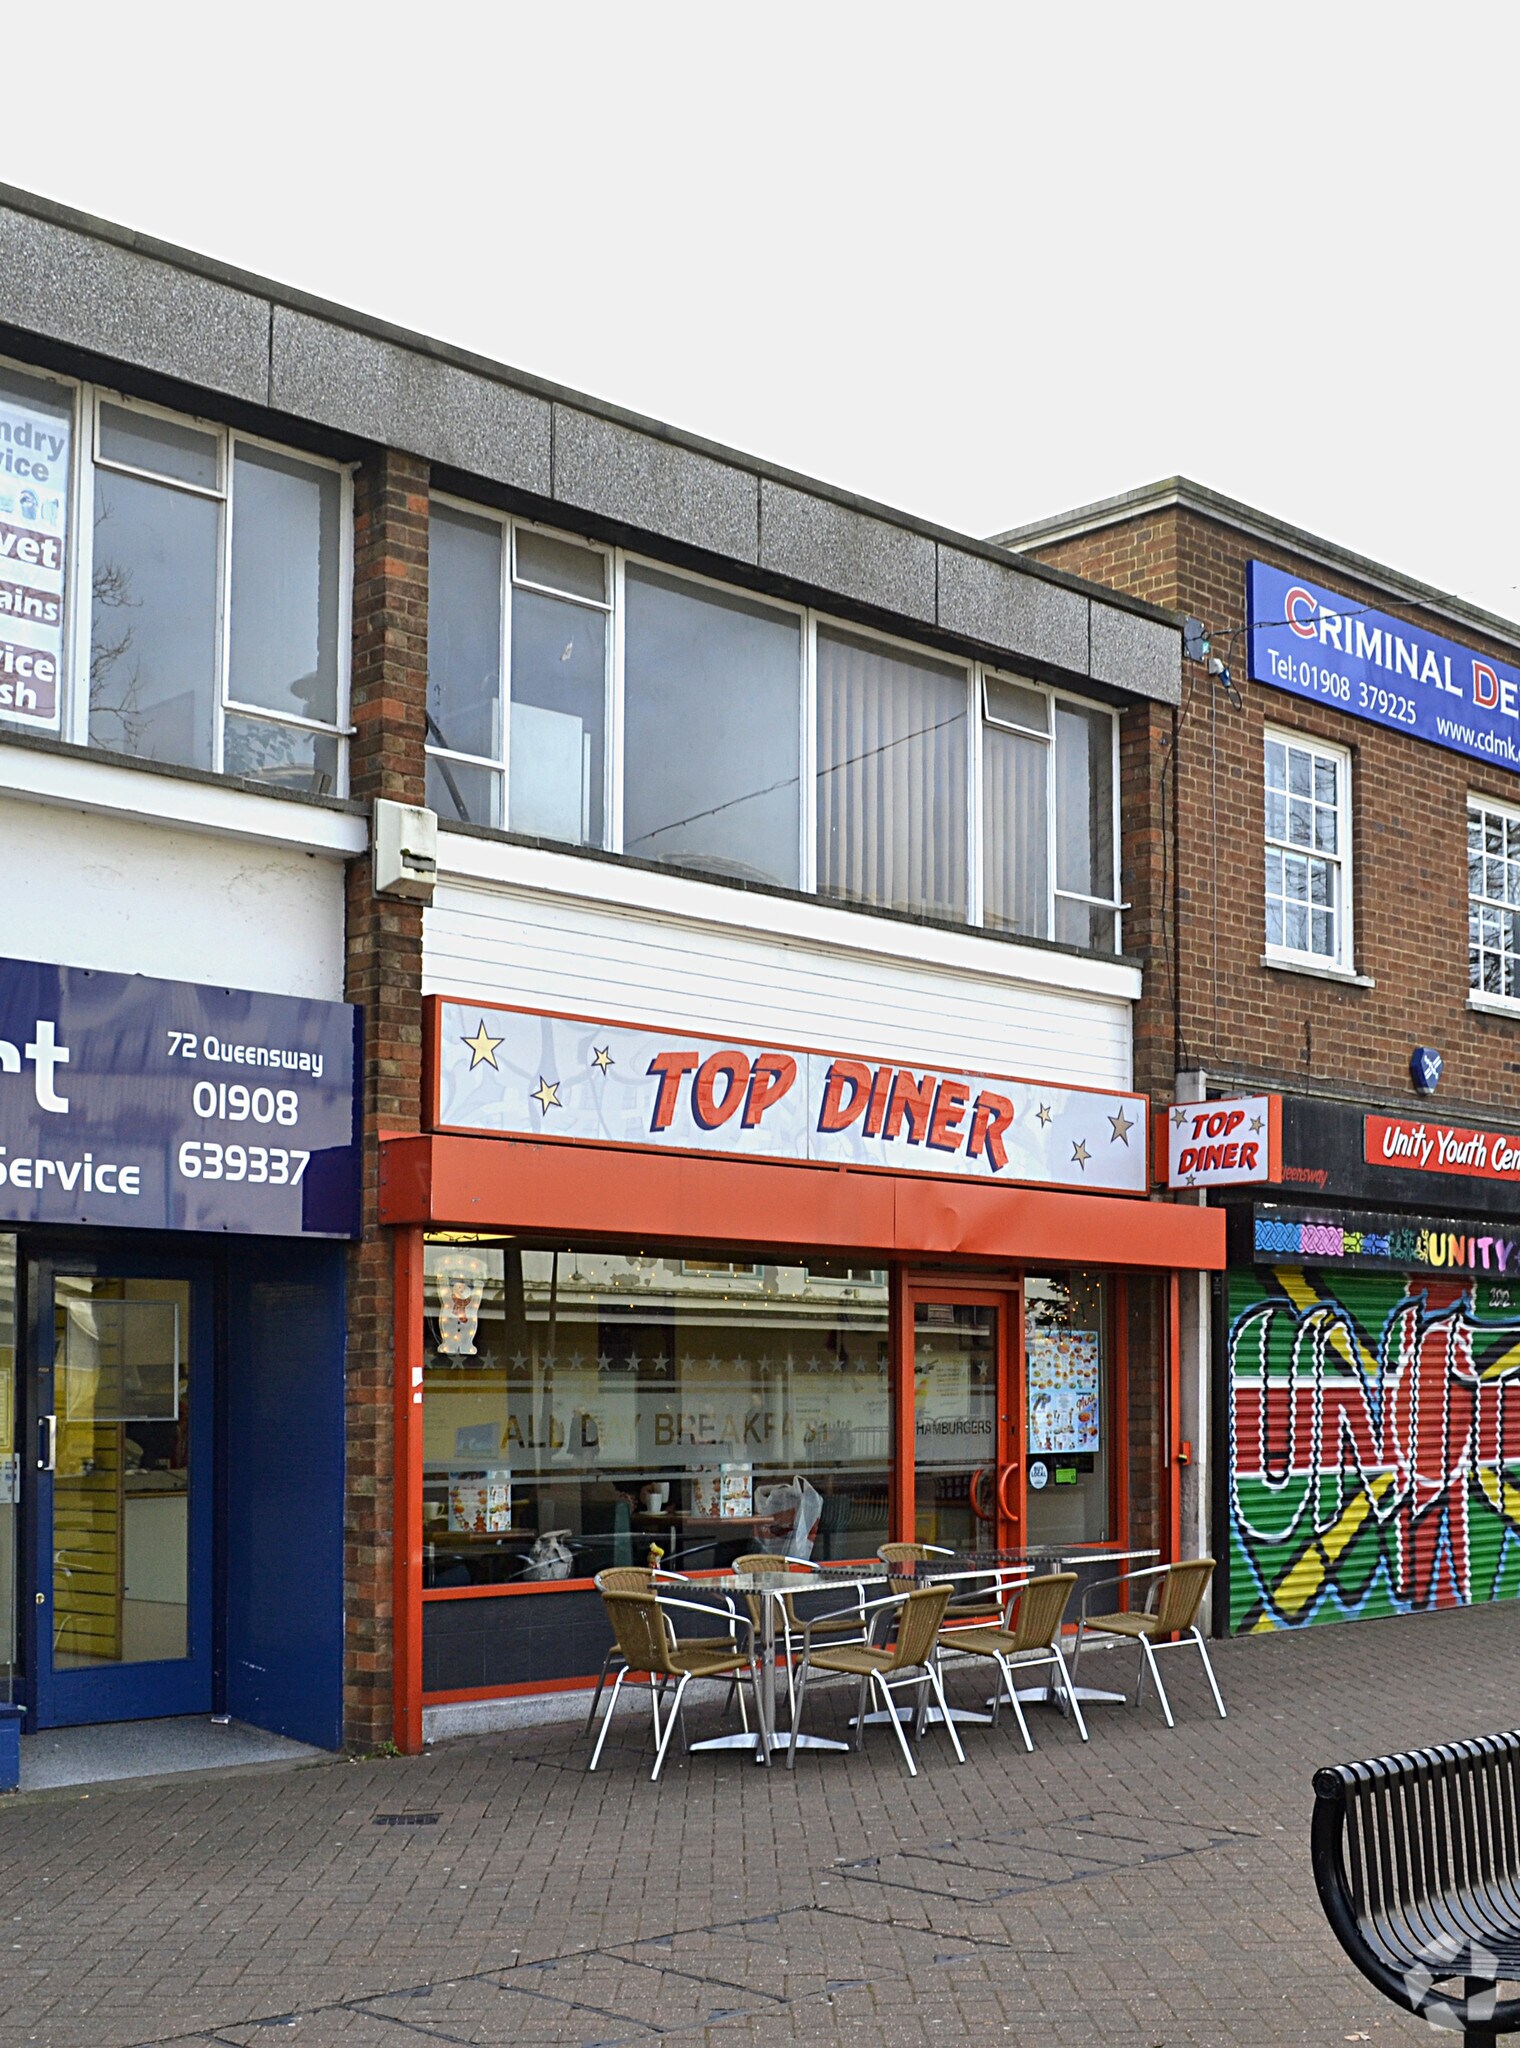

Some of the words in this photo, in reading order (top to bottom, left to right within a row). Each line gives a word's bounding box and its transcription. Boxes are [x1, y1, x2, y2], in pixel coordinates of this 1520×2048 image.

[1284, 586, 1463, 697] CRIMINAL
[1359, 681, 1417, 725] 379225
[167, 1031, 198, 1059] 72
[203, 1036, 323, 1078] Queensway
[192, 1081, 299, 1126] 01908
[646, 1050, 797, 1133] TOP
[817, 1059, 1015, 1174] DINER
[1191, 1110, 1245, 1140] TOP
[178, 1141, 310, 1186] 639337
[1178, 1142, 1260, 1175] DINER
[1382, 1124, 1435, 1168] Unity
[1437, 1130, 1487, 1168] Youth
[1428, 1232, 1514, 1272] UNITY
[916, 1420, 992, 1436] HAMBURGERS
